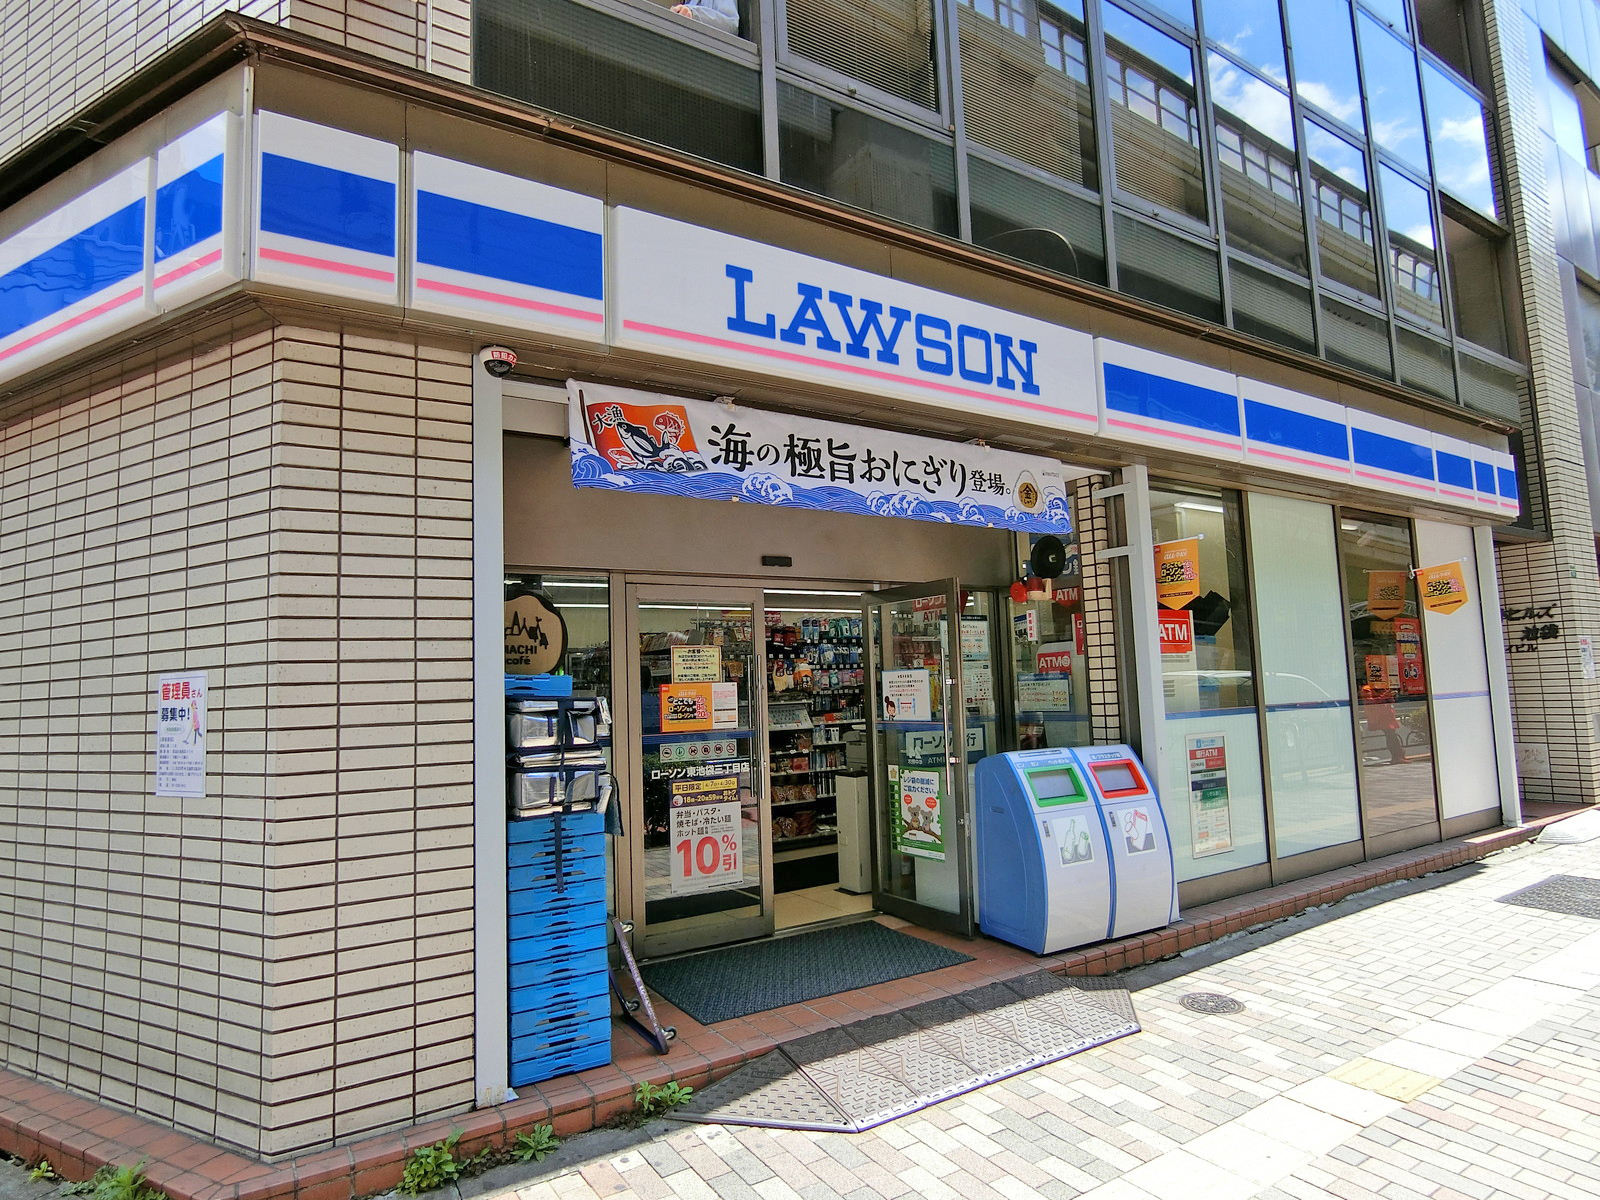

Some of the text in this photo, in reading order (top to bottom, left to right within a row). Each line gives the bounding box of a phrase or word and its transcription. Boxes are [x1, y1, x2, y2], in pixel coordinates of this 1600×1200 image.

[725, 263, 1040, 396] LAWSON
[592, 405, 626, 433] 大漁
[1022, 485, 1034, 499] 金
[1056, 588, 1078, 601] ATM
[1158, 623, 1188, 641] ATM
[1039, 656, 1061, 668] ATM
[162, 682, 203, 700] 管理員さん
[651, 762, 750, 780] ローソン 東池袋三丁目店
[674, 783, 701, 792] 平日限定
